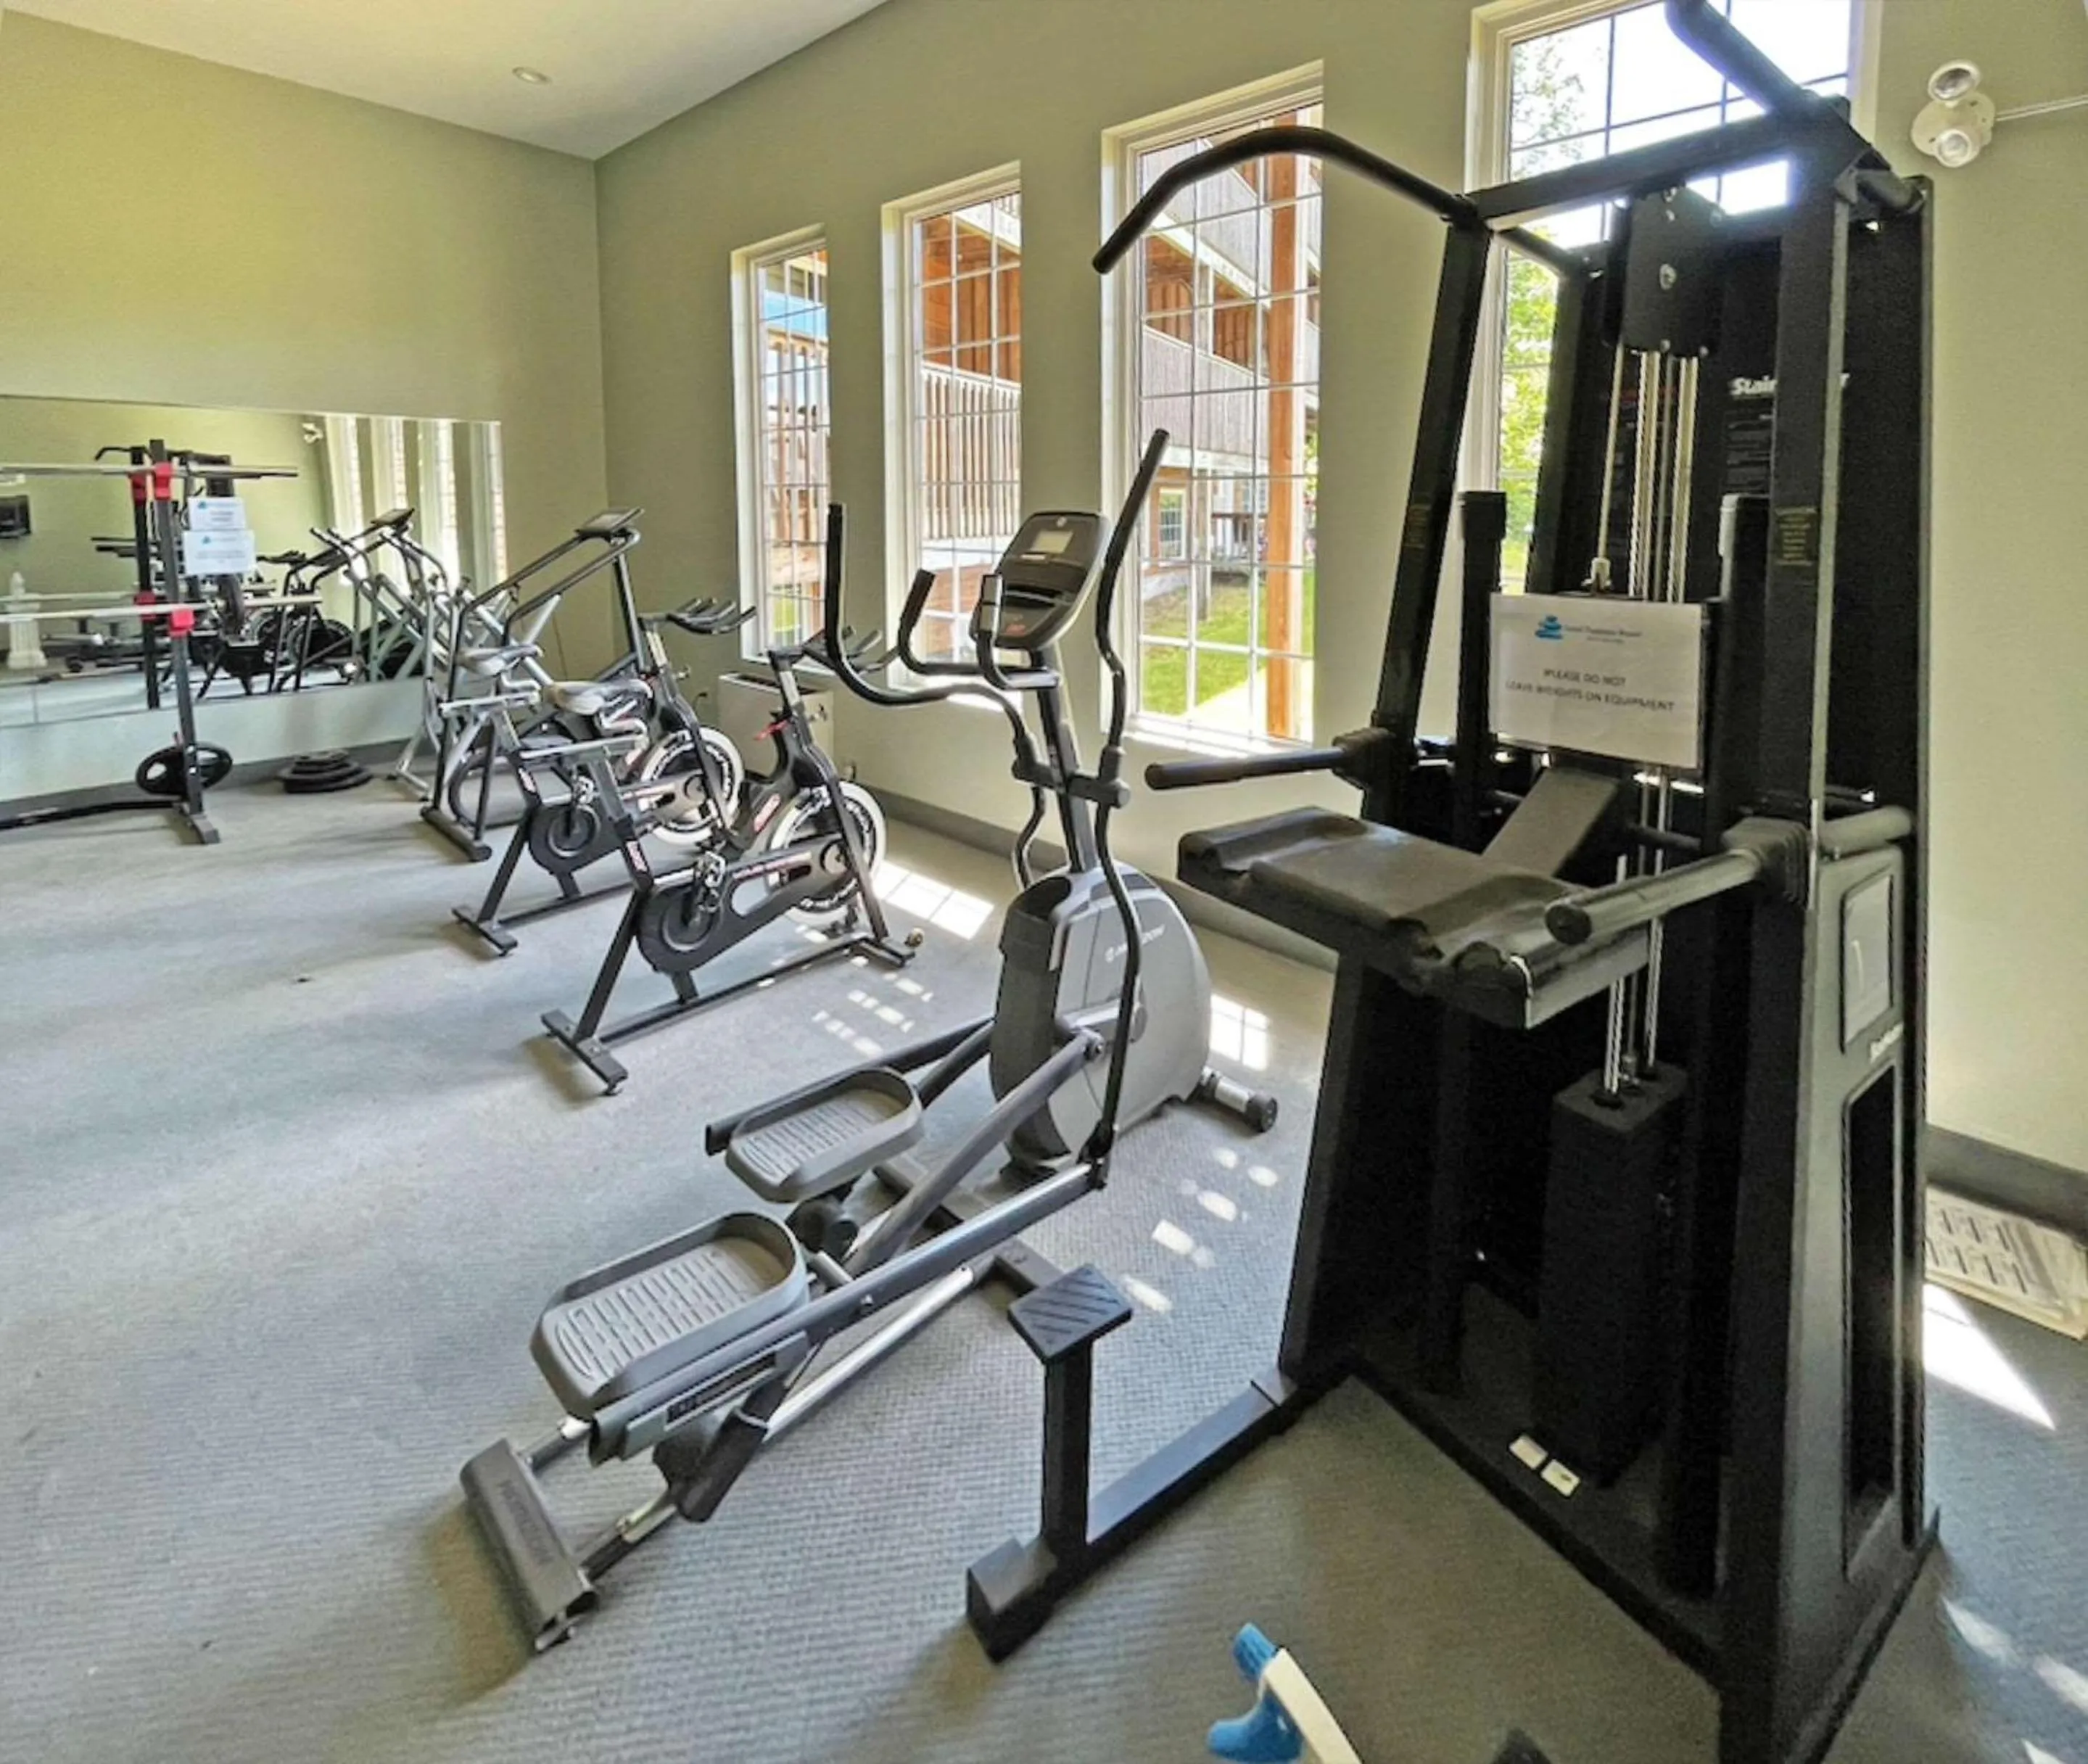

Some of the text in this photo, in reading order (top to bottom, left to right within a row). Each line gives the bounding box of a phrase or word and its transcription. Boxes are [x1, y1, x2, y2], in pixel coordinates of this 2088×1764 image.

[1543, 668, 1627, 687] PLEASE DO NOT
[1506, 679, 1675, 711] LEAVE WEIGHTS ON EQUIPMENT
